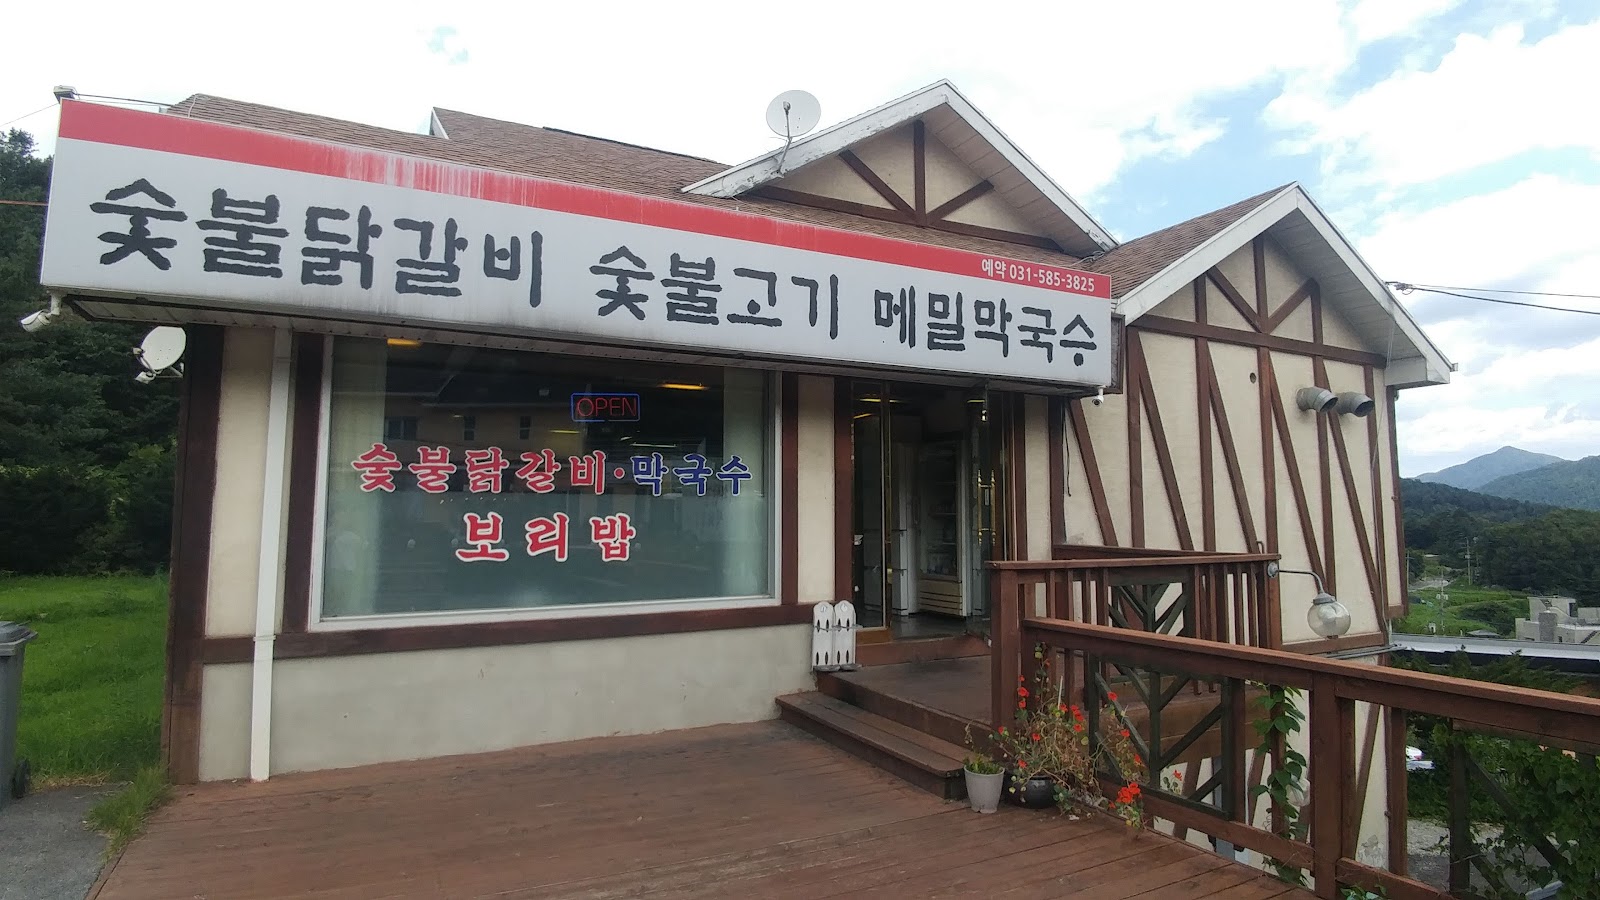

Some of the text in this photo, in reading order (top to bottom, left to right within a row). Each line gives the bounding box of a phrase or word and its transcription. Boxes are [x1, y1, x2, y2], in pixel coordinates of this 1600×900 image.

[90, 178, 1098, 367] 숯불닭갈비 숯불고기 메밀막국수
[981, 258, 1095, 292] 예약 031-585-3825
[576, 397, 637, 417] OPEN
[455, 510, 636, 563] 보리밥
